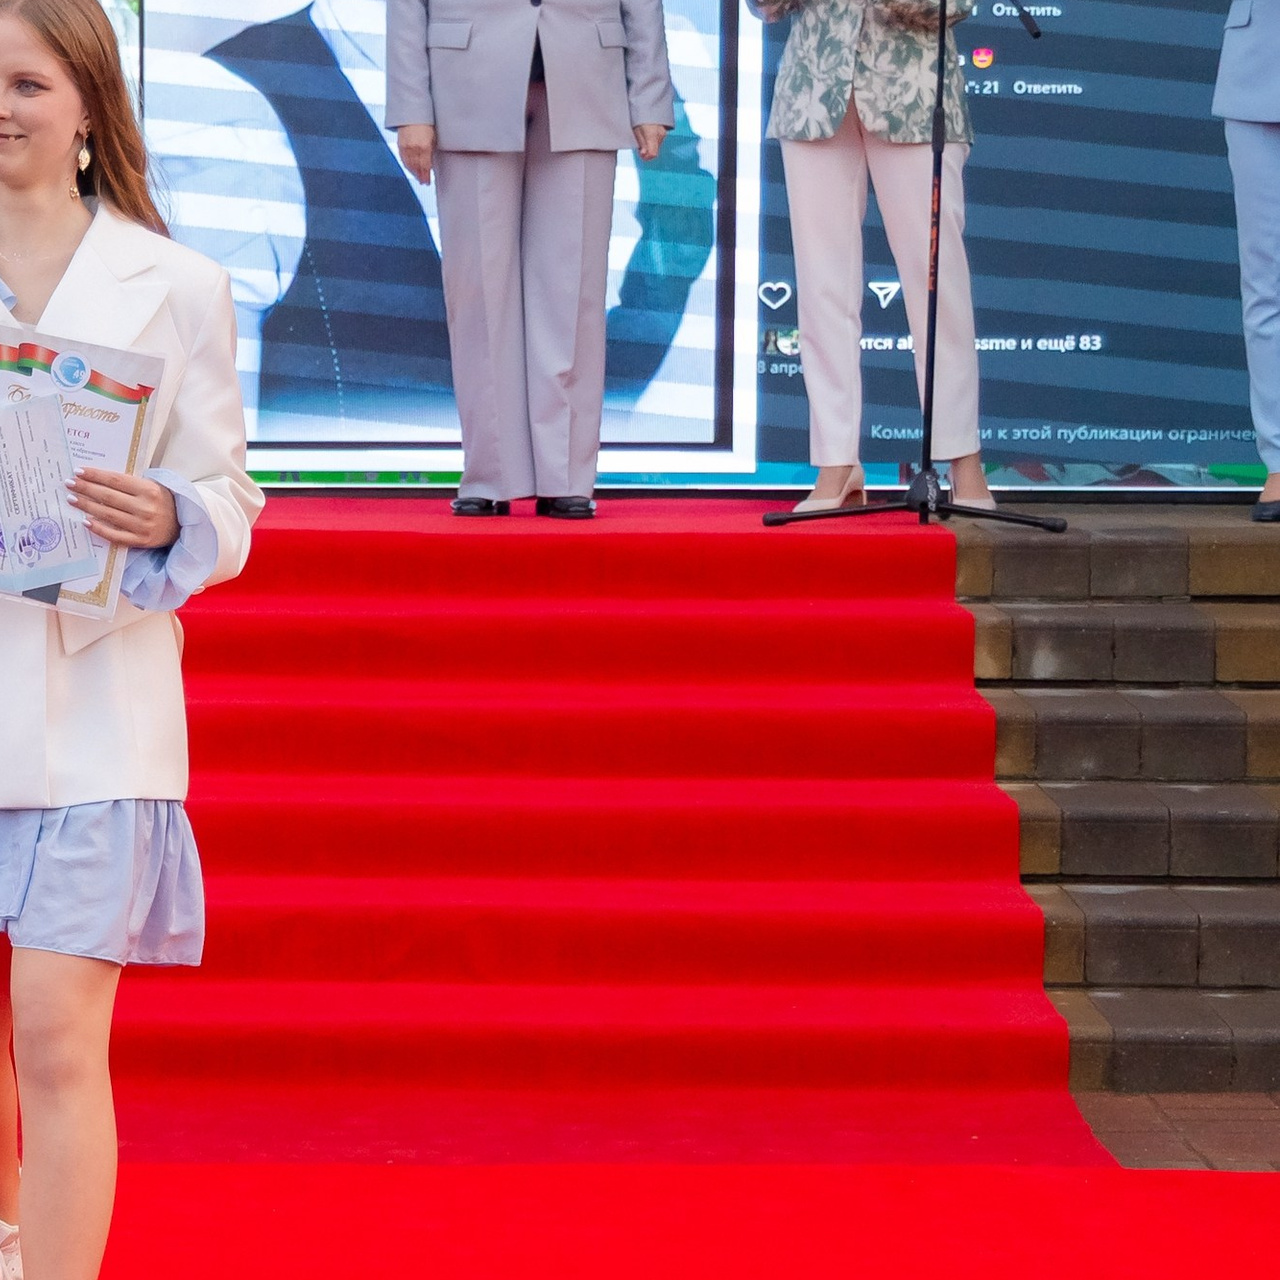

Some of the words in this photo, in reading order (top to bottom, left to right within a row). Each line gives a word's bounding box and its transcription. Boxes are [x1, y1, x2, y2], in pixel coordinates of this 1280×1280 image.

[983, 81, 1000, 94] 21
[1013, 81, 1083, 94] Ответить
[1021, 338, 1033, 351] и
[1036, 335, 1076, 353] ещё
[1079, 334, 1102, 351] 83
[998, 428, 1008, 440] к
[1012, 425, 1052, 440] этой
[1057, 425, 1163, 444] публикации
